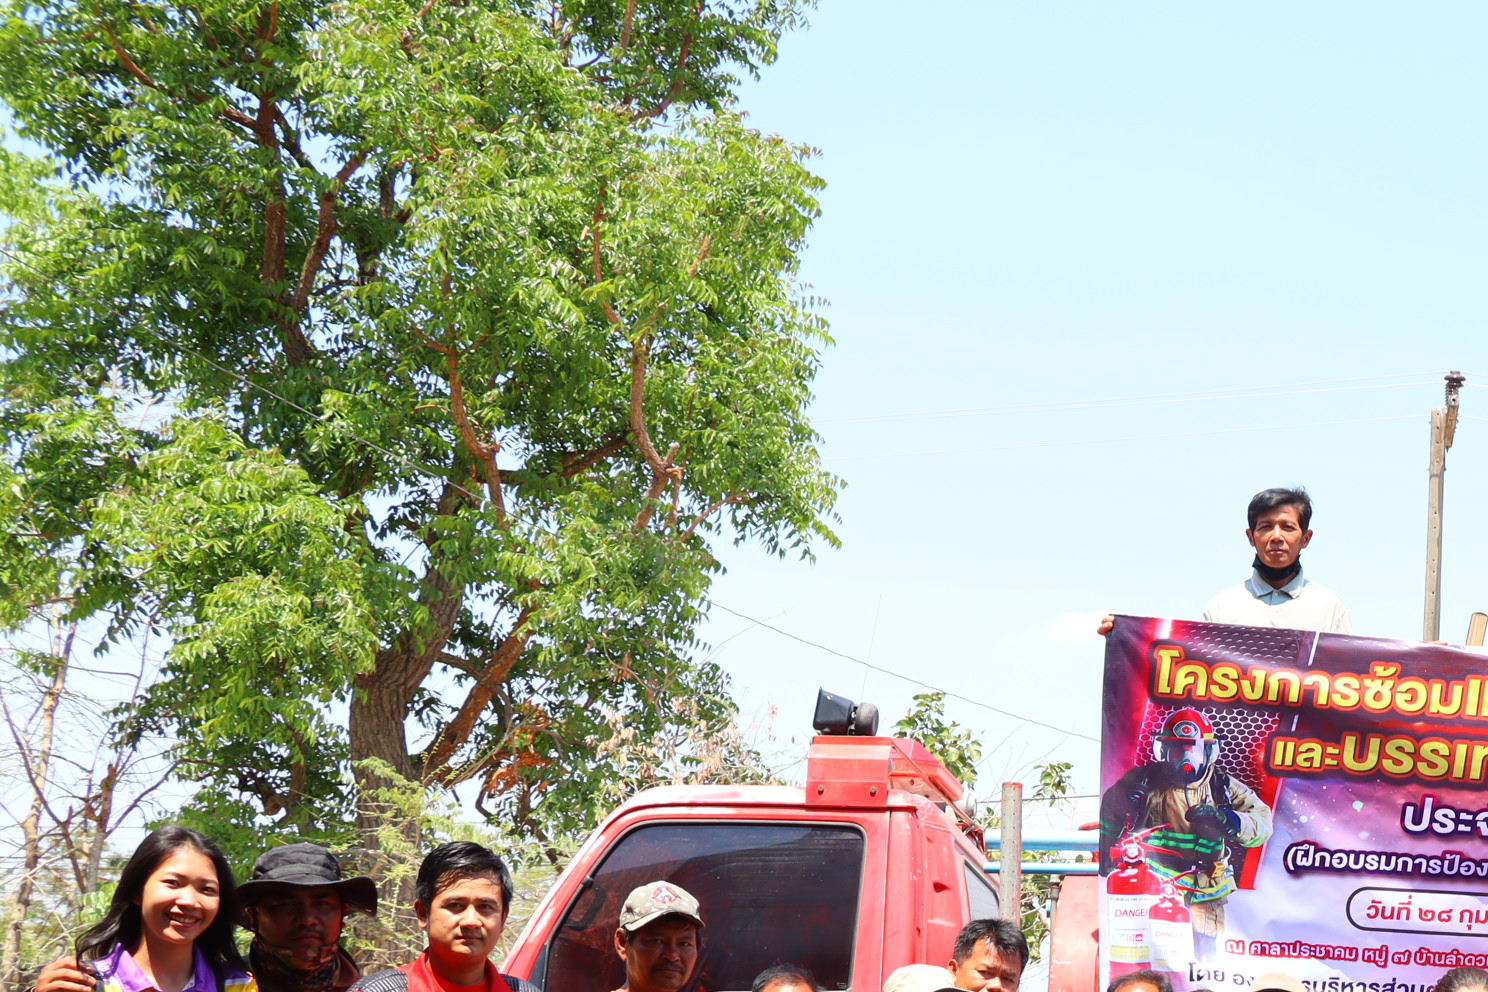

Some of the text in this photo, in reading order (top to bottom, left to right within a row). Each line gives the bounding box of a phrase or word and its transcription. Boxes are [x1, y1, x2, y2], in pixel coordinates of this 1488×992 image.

[1366, 895, 1413, 920] วันที่
[1417, 908, 1452, 924] ๒๘
[1225, 939, 1245, 954] ณ
[1250, 941, 1357, 961] ศาลาประชาคม
[1363, 945, 1388, 968] หมู่
